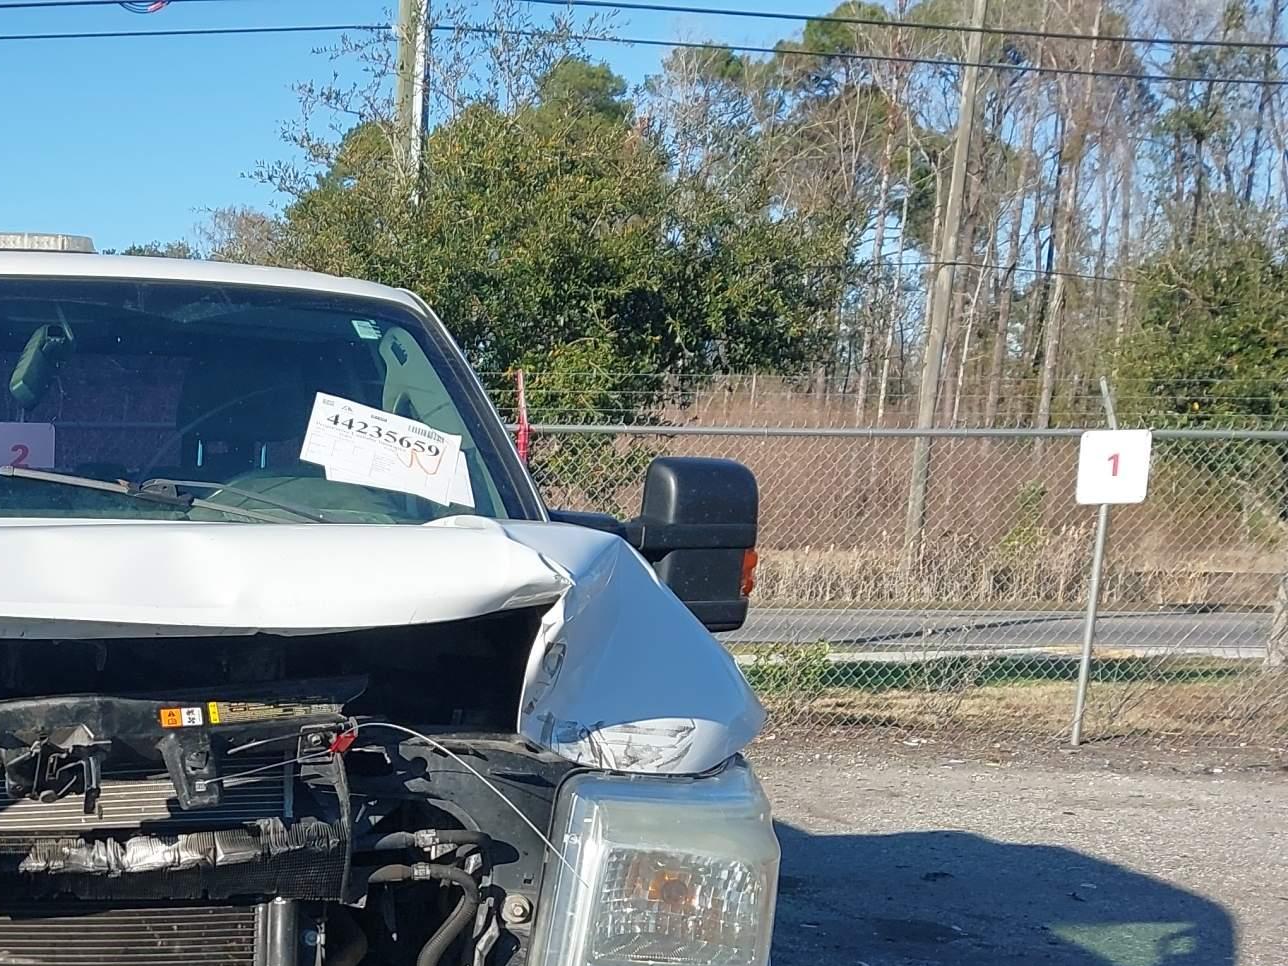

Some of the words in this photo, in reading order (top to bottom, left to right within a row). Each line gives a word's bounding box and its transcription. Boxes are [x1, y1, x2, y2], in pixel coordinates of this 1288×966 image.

[327, 414, 440, 456] 44235659
[9, 444, 30, 468] 2
[1107, 453, 1121, 477] 1
